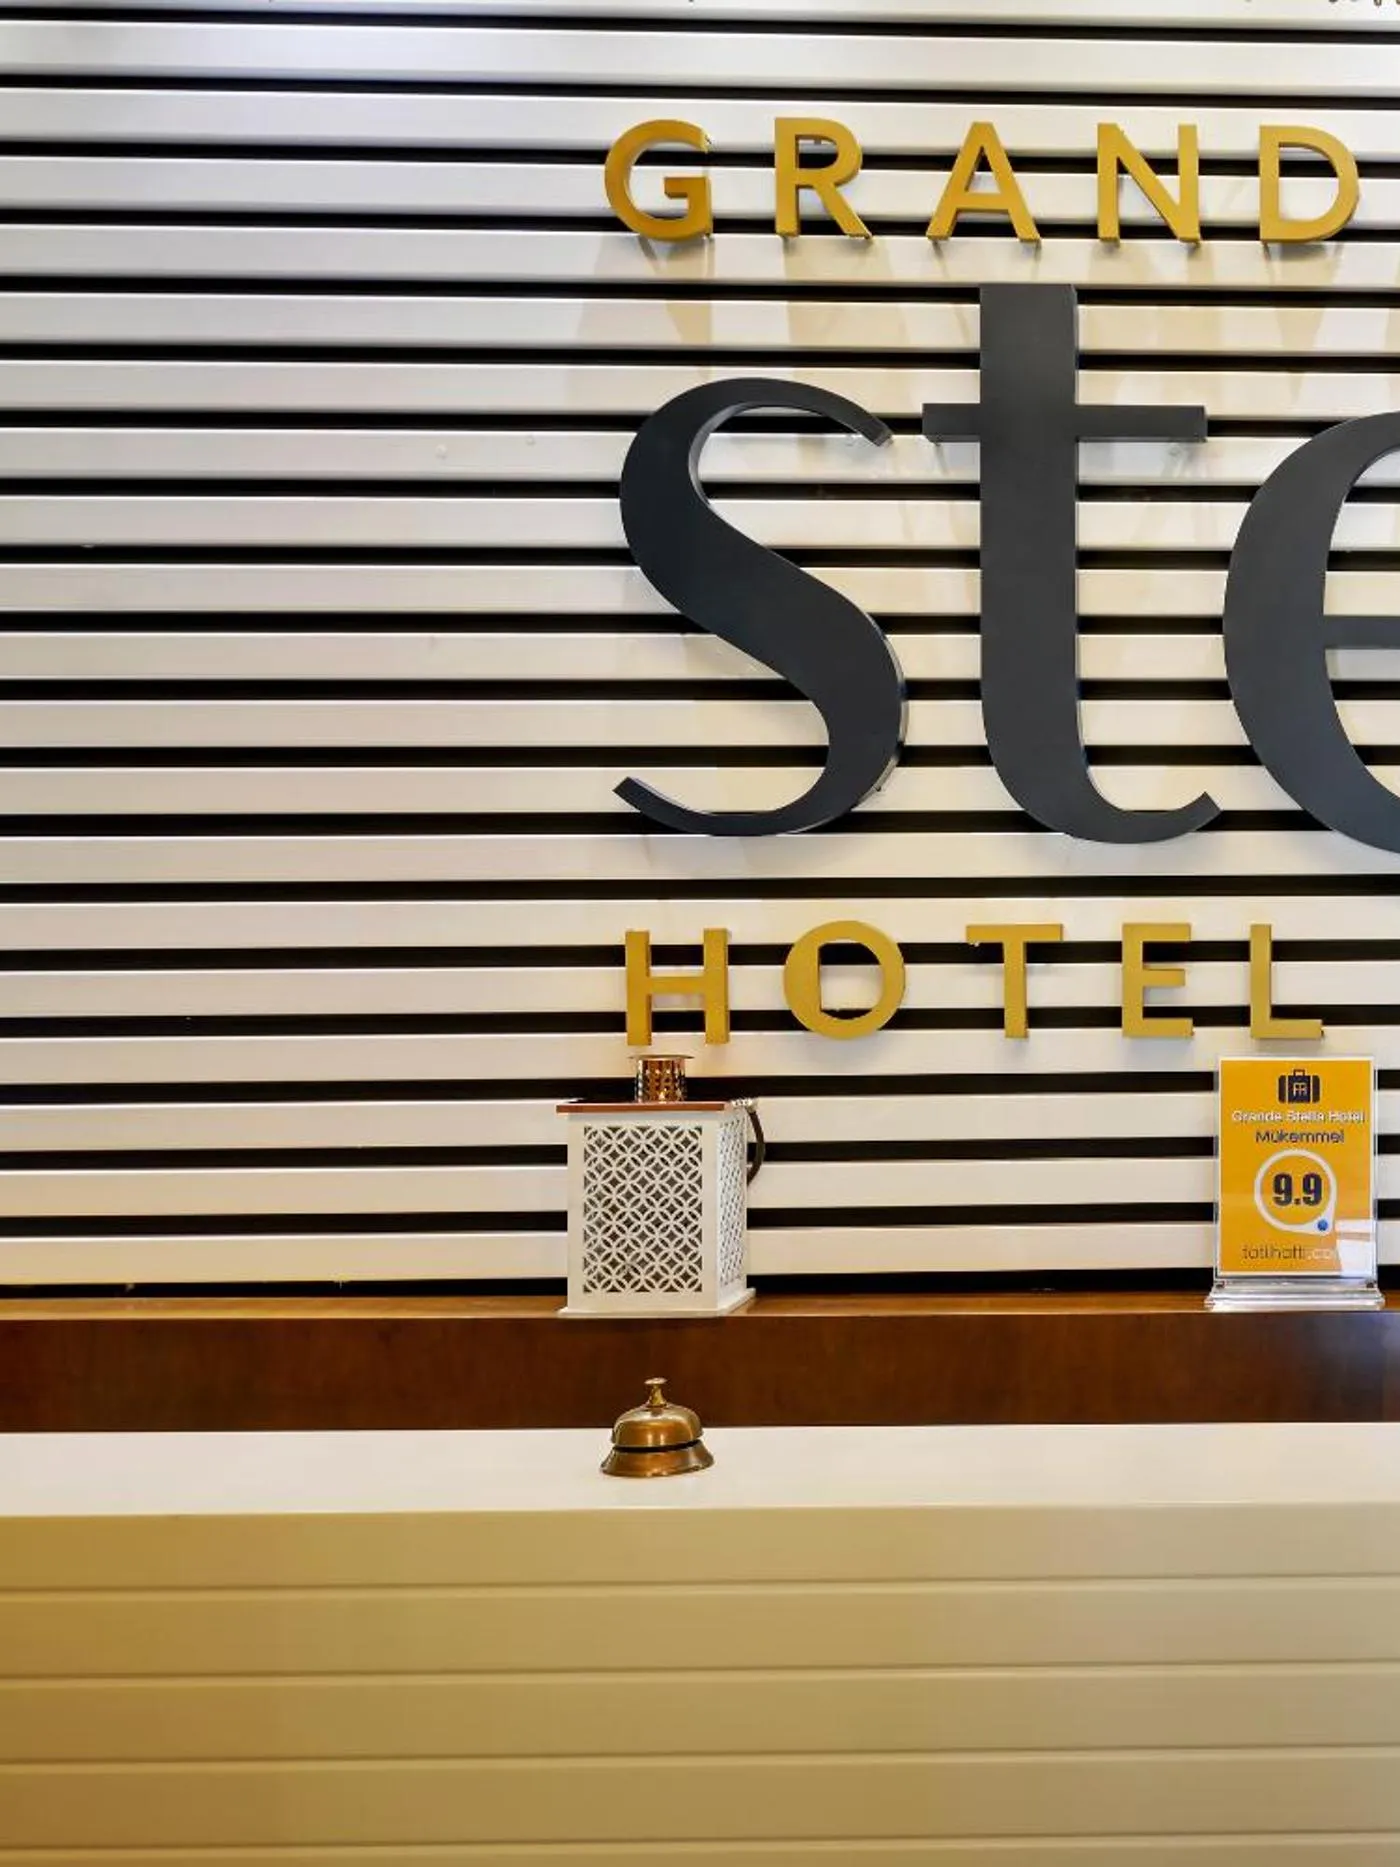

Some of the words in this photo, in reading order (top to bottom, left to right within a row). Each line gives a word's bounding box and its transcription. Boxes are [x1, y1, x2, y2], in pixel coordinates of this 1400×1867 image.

[625, 919, 1325, 1047] HOTEL
[1232, 1110, 1282, 1123] Grande
[1286, 1110, 1325, 1122] Stella
[1328, 1110, 1366, 1123] Hotel
[1255, 1129, 1345, 1144] Mükemmel
[1272, 1172, 1323, 1207] 9.9
